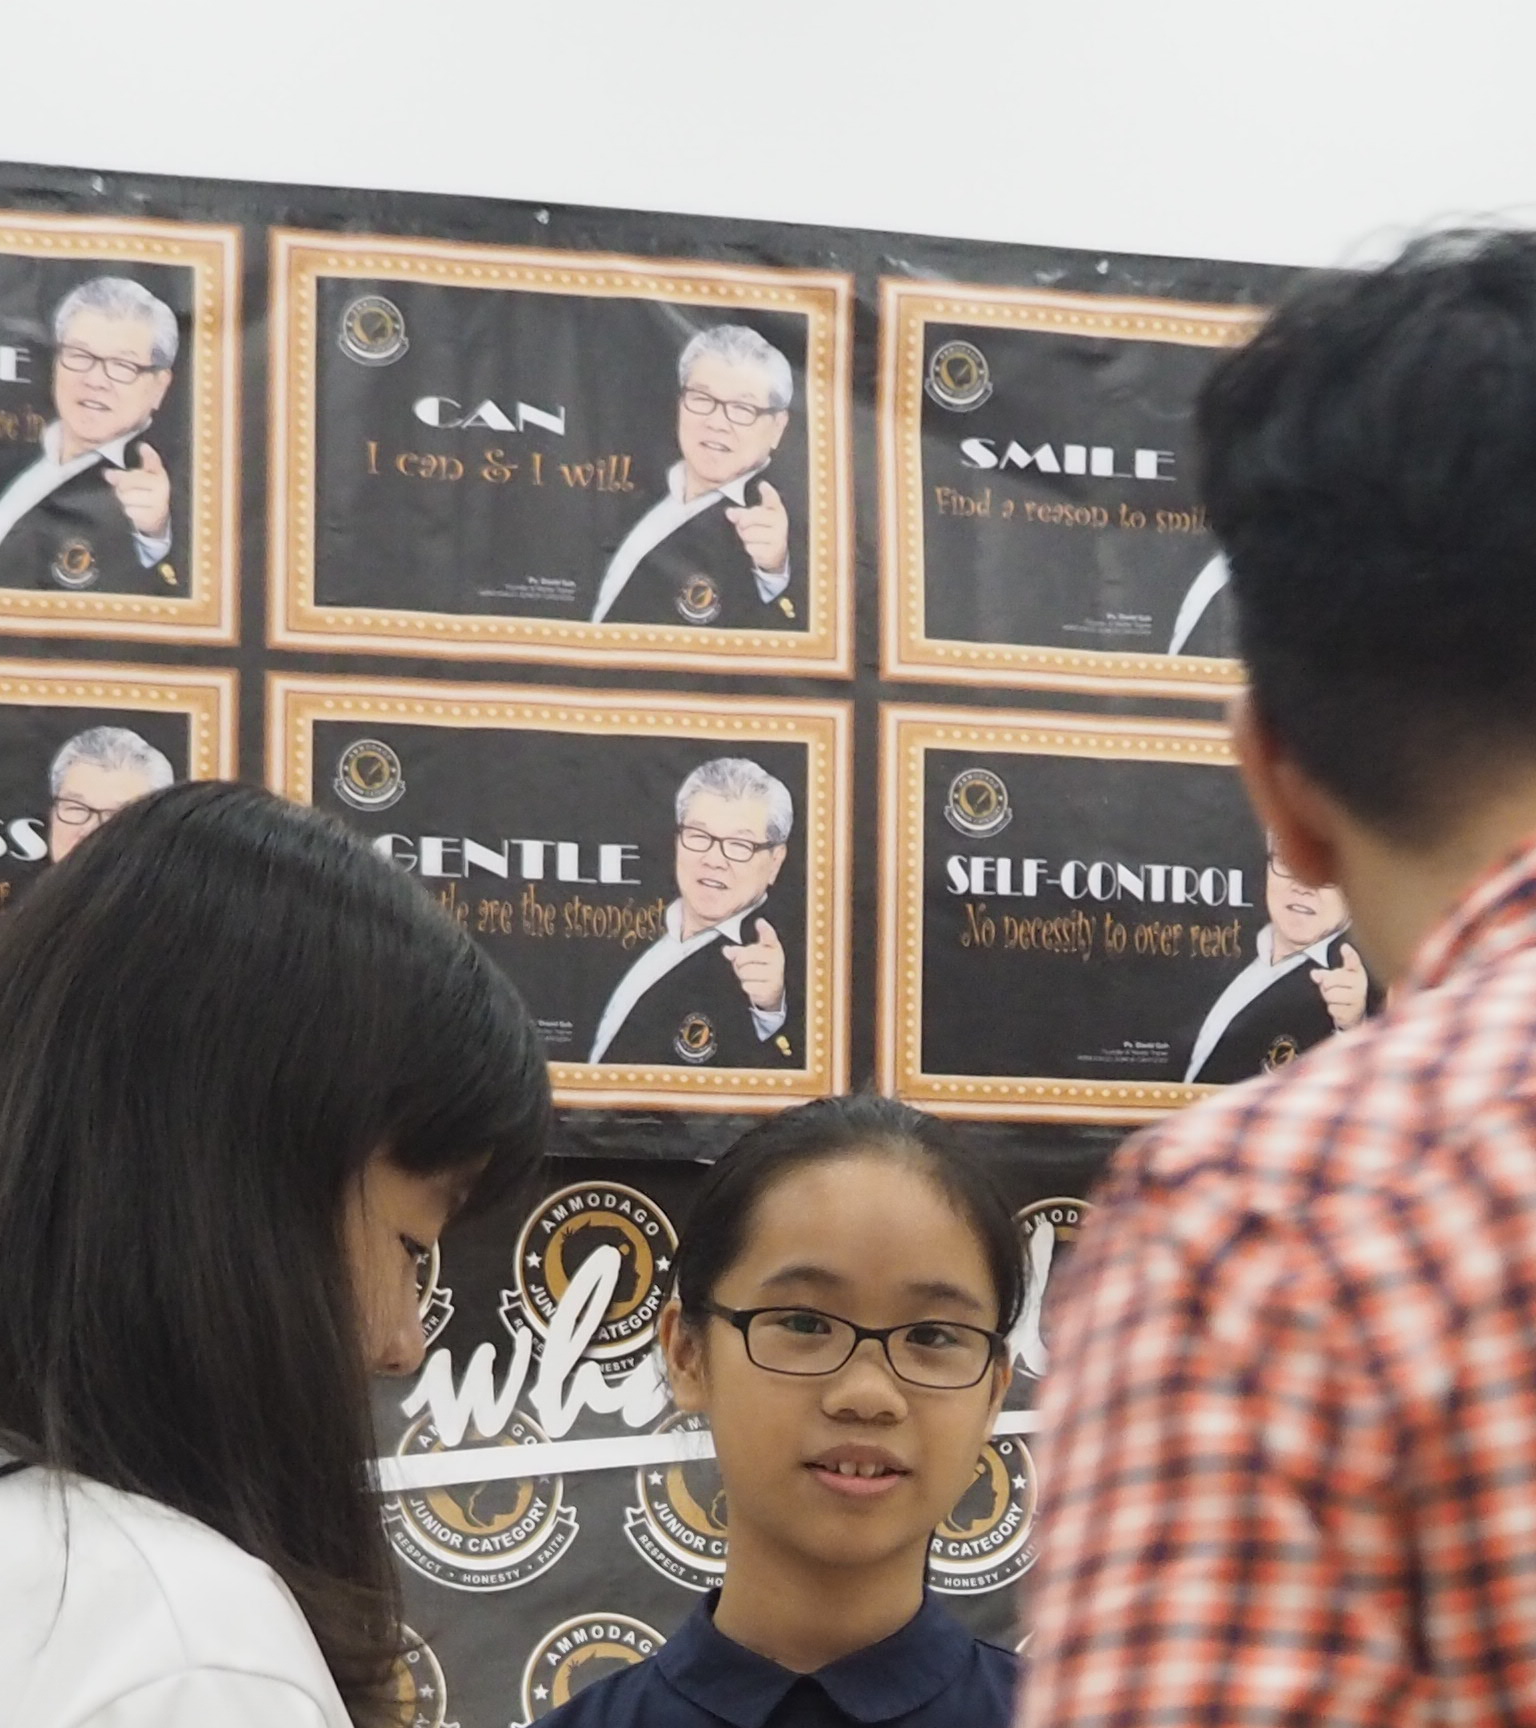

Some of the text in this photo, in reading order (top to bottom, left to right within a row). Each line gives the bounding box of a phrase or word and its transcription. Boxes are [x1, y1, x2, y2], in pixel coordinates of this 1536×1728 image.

[413, 396, 565, 436] CAN
[366, 440, 380, 476] I
[395, 450, 464, 481] can
[481, 447, 519, 483] &
[530, 452, 545, 486] I
[960, 437, 1176, 481] SMILE
[934, 486, 992, 519] Find
[1119, 502, 1147, 530] to
[1155, 504, 1210, 535] smil
[372, 833, 642, 885] GENTLE
[946, 854, 1254, 907] SELF-CONTROL
[478, 898, 513, 935] are
[522, 882, 557, 937] the
[564, 894, 666, 951] strongest
[960, 902, 1242, 961] No necessity to over react
[539, 1193, 660, 1235] AMMODAGO
[530, 1284, 557, 1318] JUN
[597, 1284, 664, 1341] ATEGORY
[410, 1496, 548, 1552] JUNIOR CATEGORY
[653, 1500, 707, 1552] JUNIOR
[948, 1501, 1024, 1556] CATEGORY
[394, 1531, 566, 1585] RESPECT HONESTY FAITH
[638, 1533, 687, 1577] RESPECT
[944, 1571, 1000, 1588] HONESTY
[546, 1624, 656, 1666] AMMODAG
